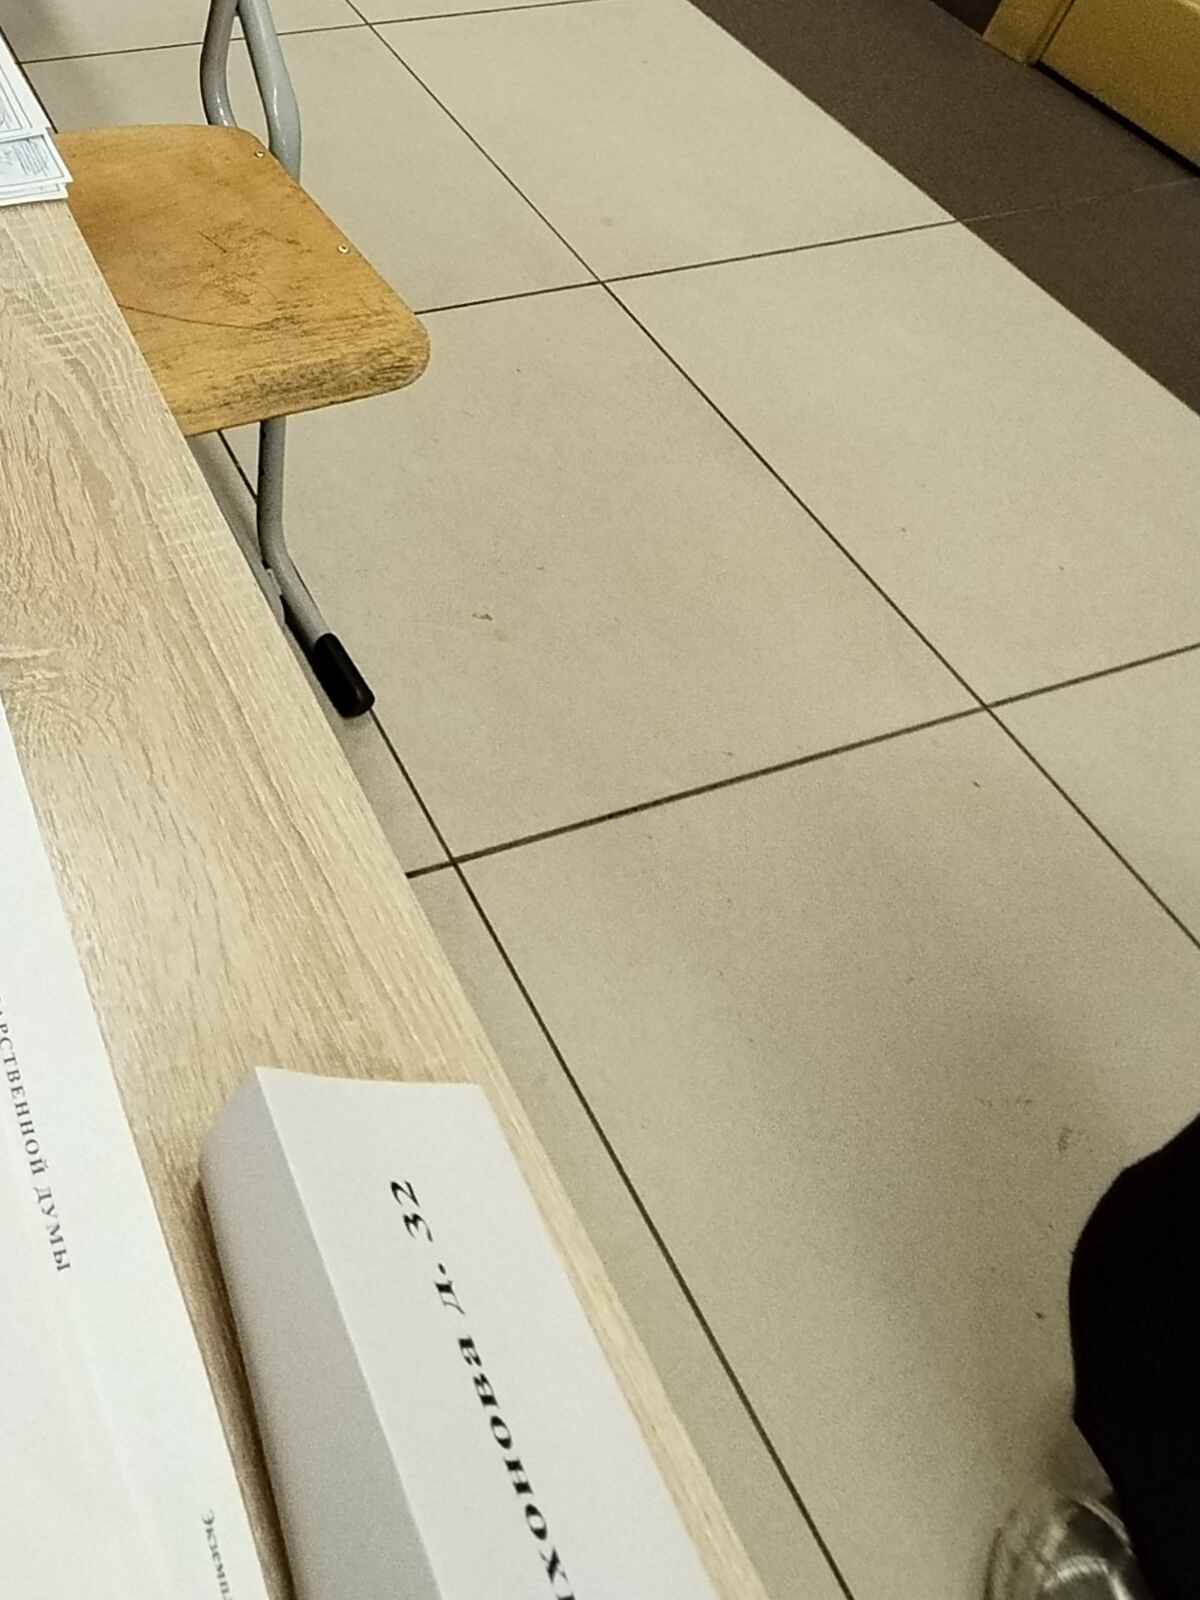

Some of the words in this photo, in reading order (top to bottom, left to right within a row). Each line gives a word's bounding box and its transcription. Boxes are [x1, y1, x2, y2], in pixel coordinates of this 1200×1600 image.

[33, 1185, 71, 1272] ДУМЫ
[389, 1180, 434, 1243] 32
[434, 1261, 466, 1316] д.
[455, 1334, 577, 1600] хонова
